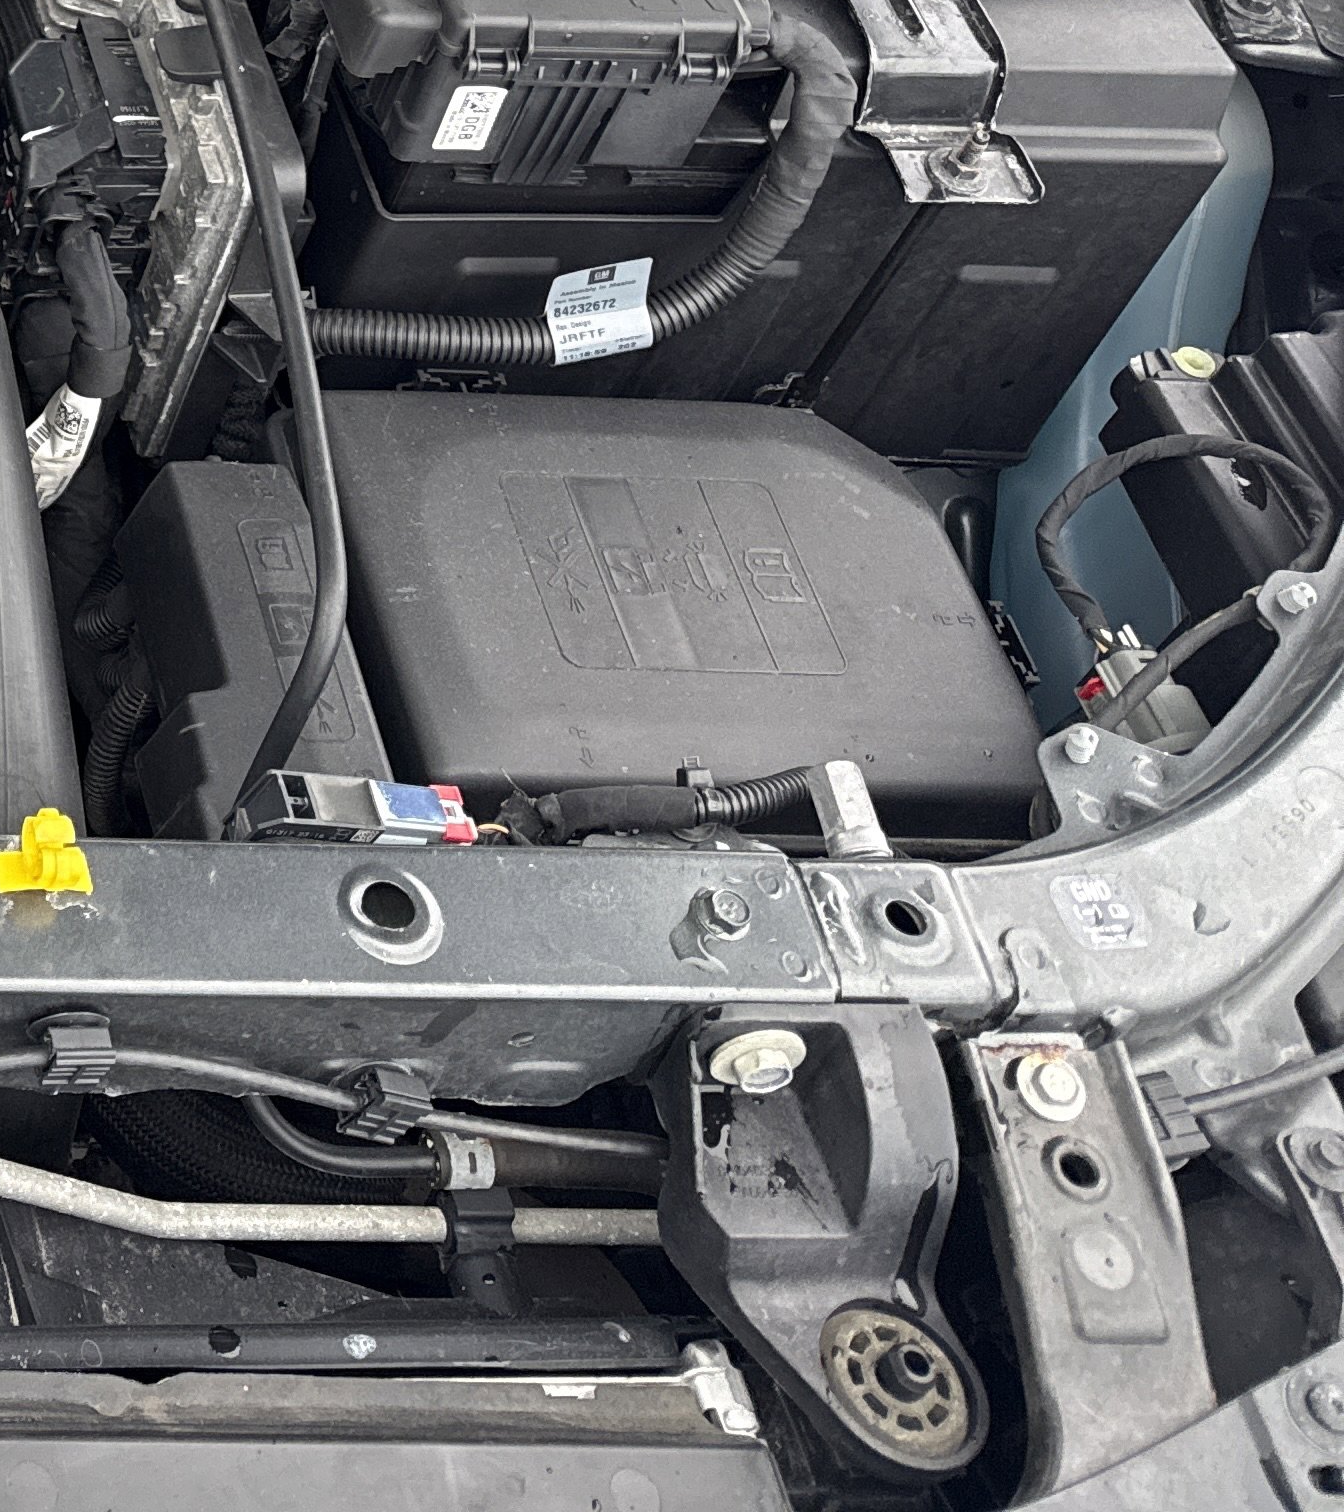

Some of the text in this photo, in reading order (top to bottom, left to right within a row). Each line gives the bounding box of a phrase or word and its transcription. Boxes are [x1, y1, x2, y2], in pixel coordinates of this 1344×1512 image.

[459, 117, 480, 139] DGB
[554, 298, 616, 318] 84232672
[560, 328, 606, 344] JRFTF
